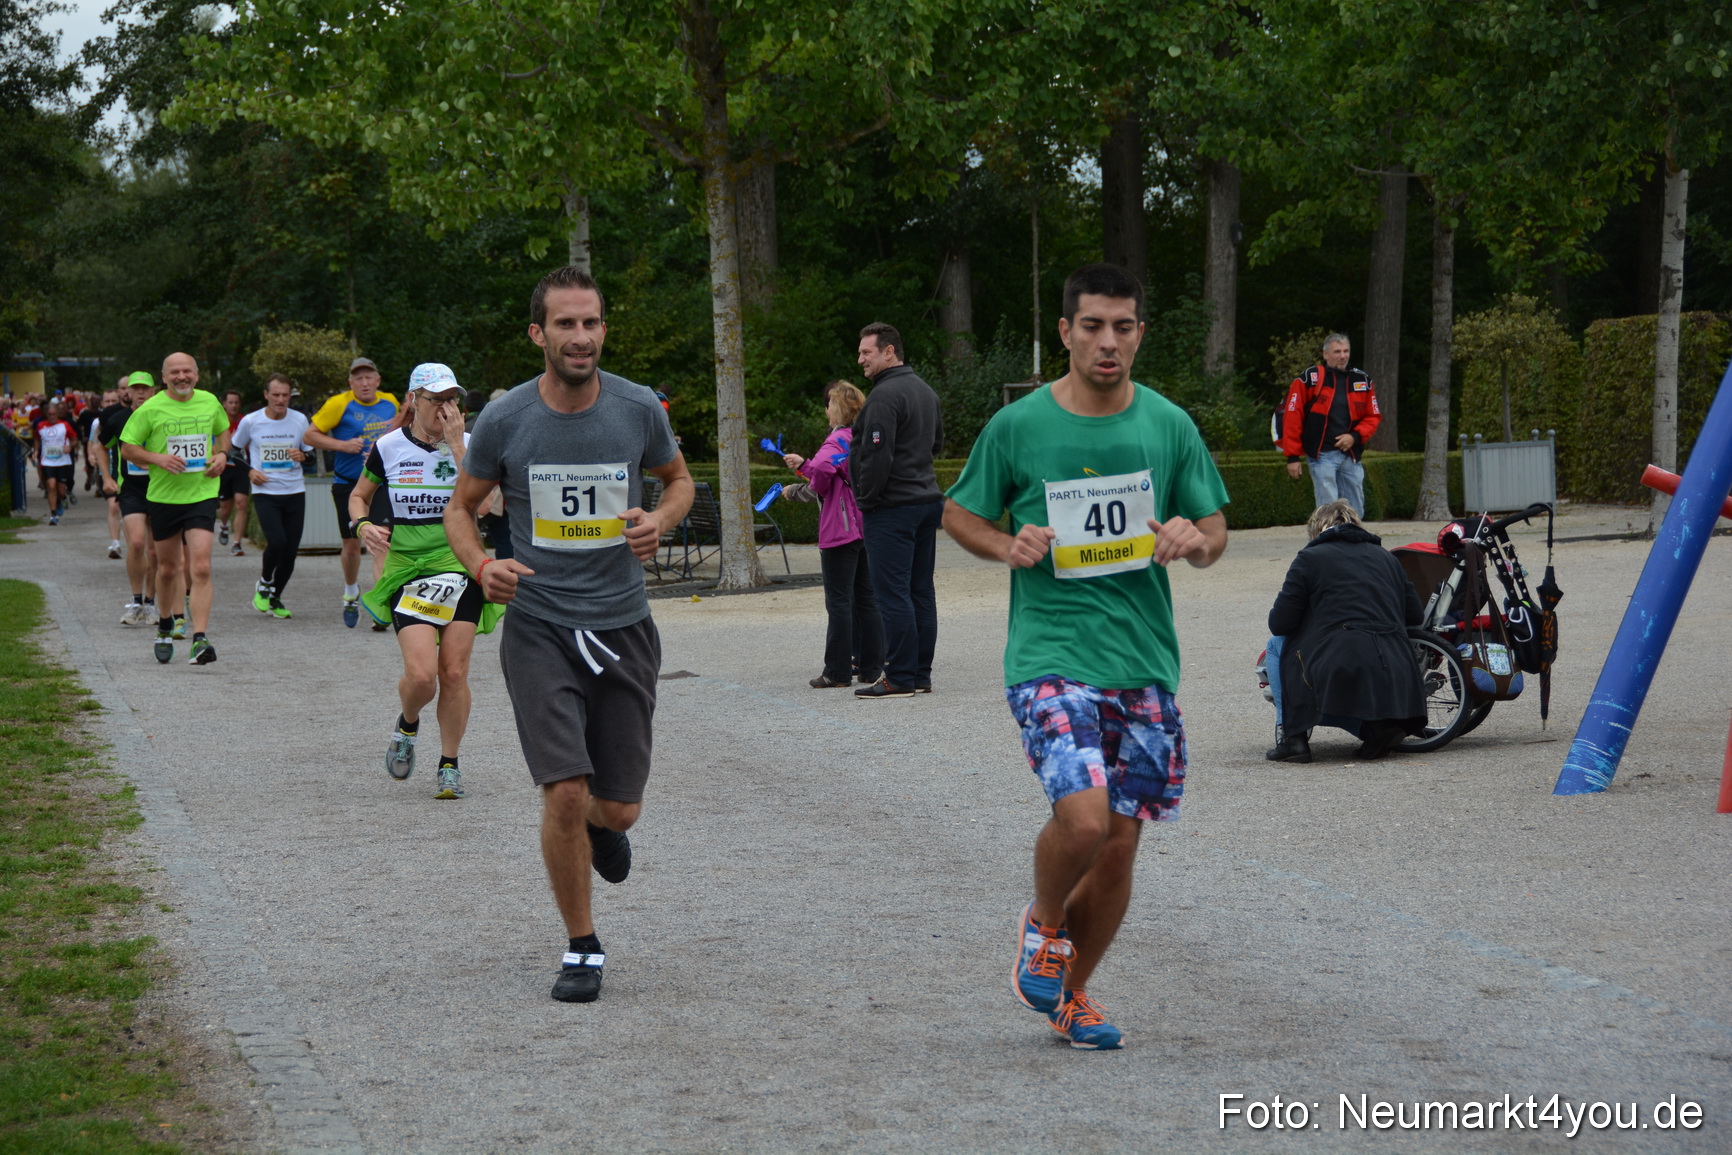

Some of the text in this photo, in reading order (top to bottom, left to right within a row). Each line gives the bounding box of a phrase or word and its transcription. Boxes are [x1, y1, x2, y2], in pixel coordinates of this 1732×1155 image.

[172, 443, 205, 458] 2153
[531, 473, 612, 482] PARTL Neumarkt
[394, 493, 451, 504] Lauftea
[1049, 485, 1138, 501] PARTL Neumarkt
[561, 486, 596, 517] 51
[1084, 500, 1127, 538] 40
[559, 525, 602, 538] Tobias
[1080, 543, 1134, 564] Michael
[416, 582, 455, 604] 279
[411, 600, 441, 616] Manuela
